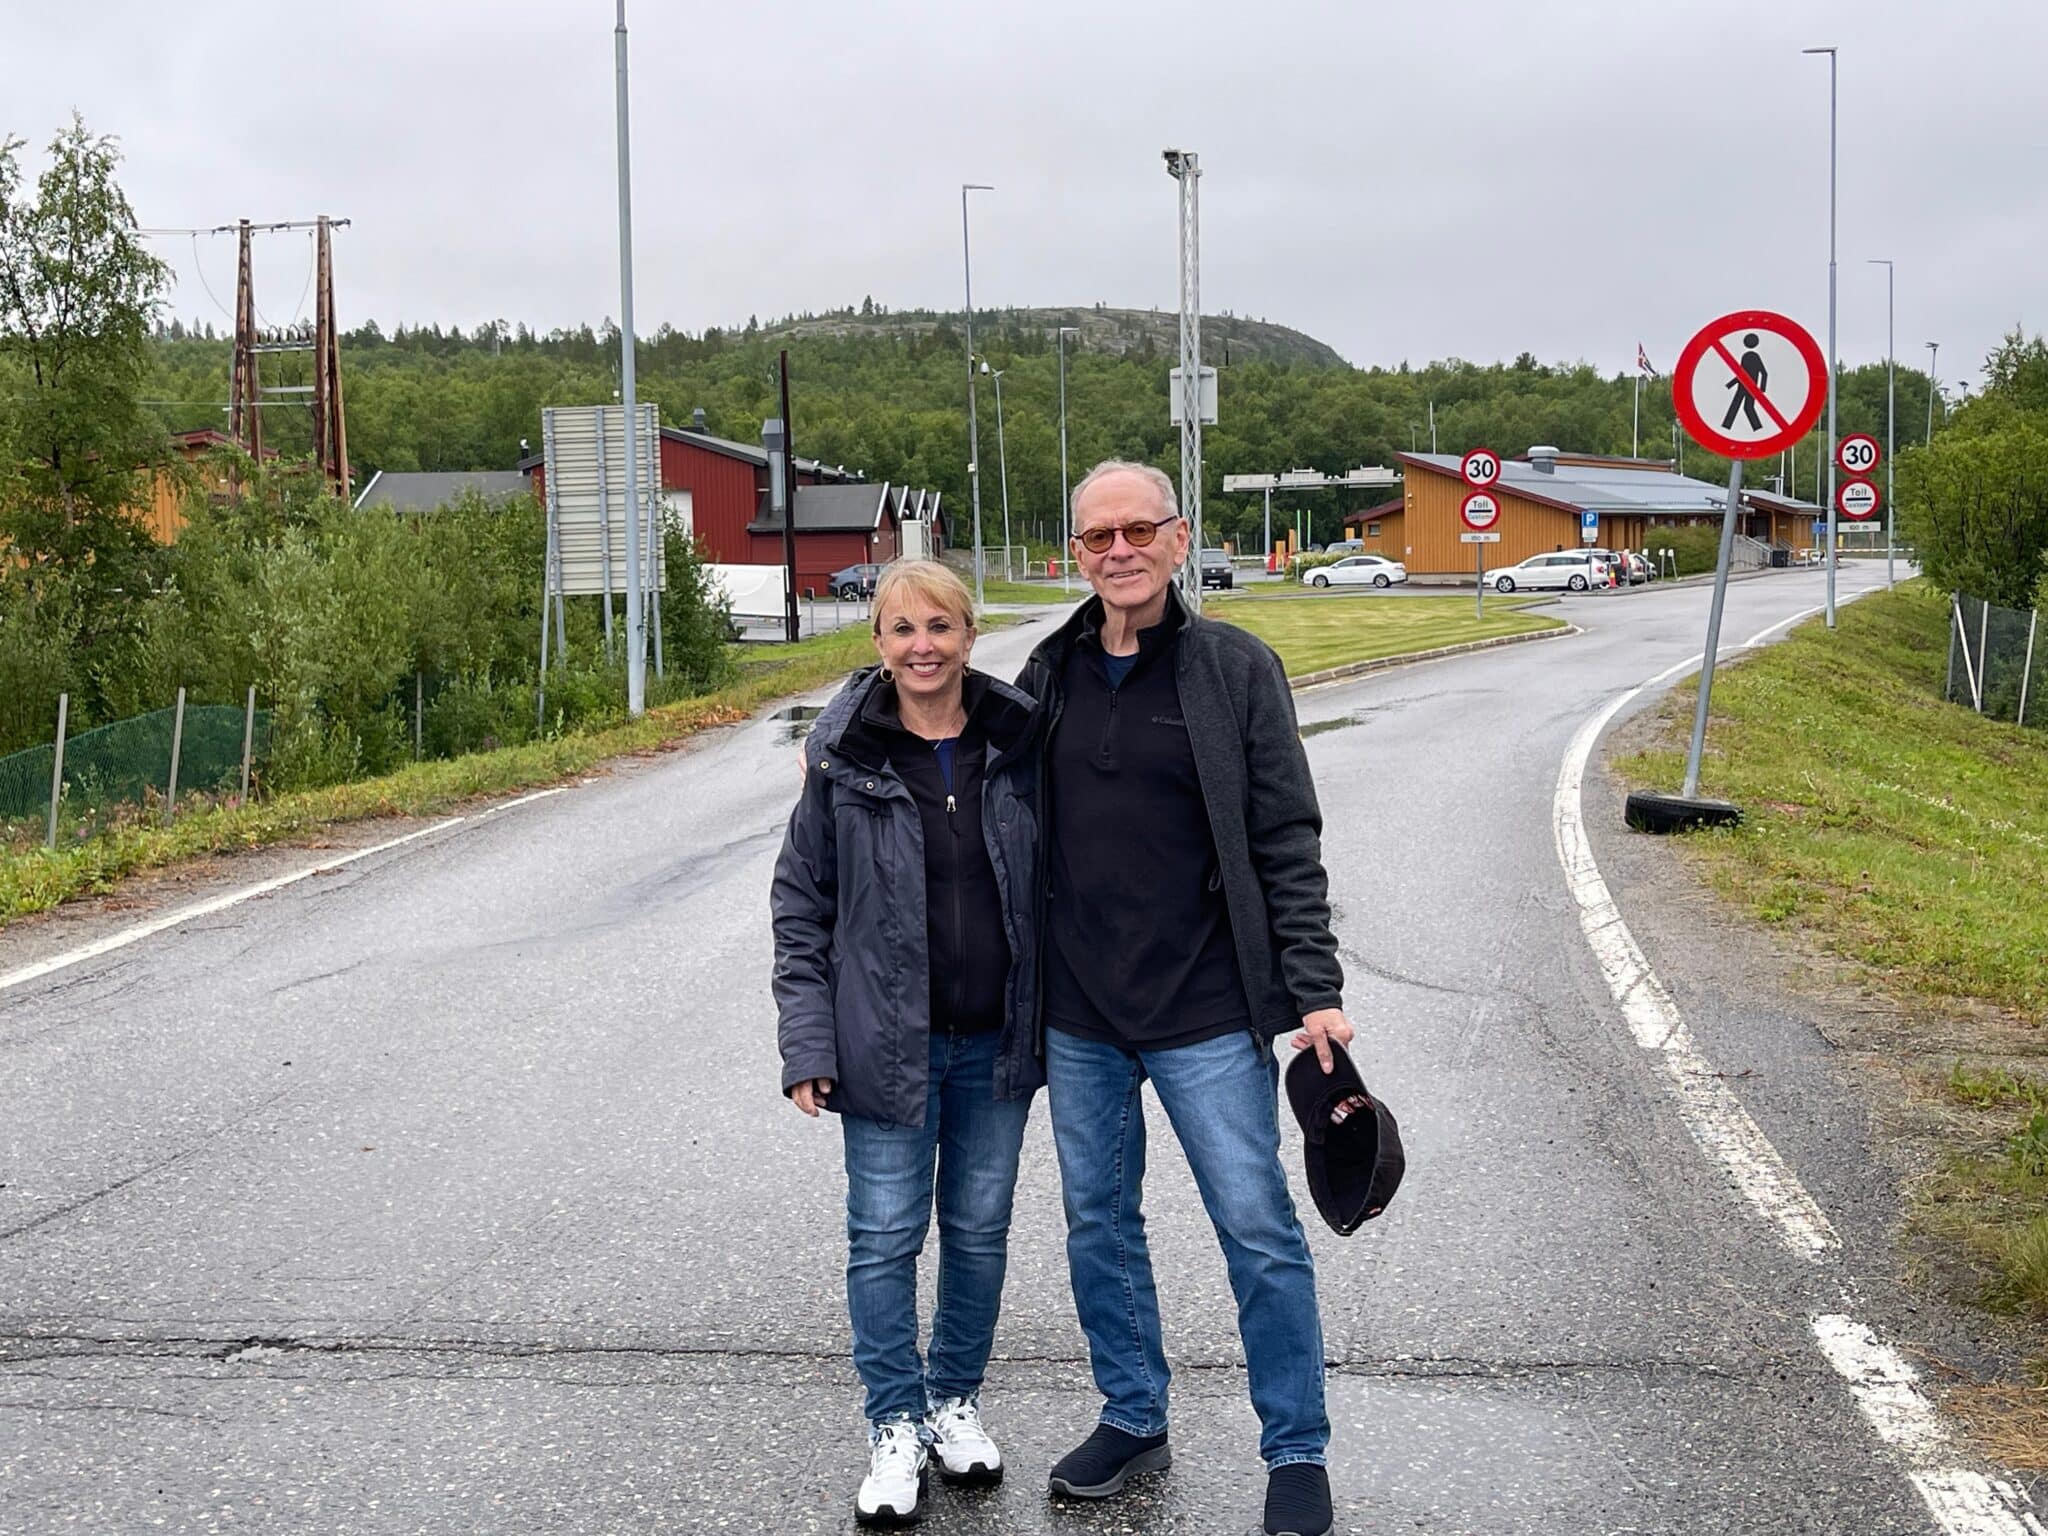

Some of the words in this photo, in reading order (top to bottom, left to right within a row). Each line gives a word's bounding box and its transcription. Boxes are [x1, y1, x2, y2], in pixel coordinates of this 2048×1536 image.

[1845, 444, 1873, 465] 30
[1469, 459, 1494, 479] 30
[1850, 488, 1867, 497] Toll
[1472, 500, 1489, 509] Toll
[1586, 513, 1595, 526] P
